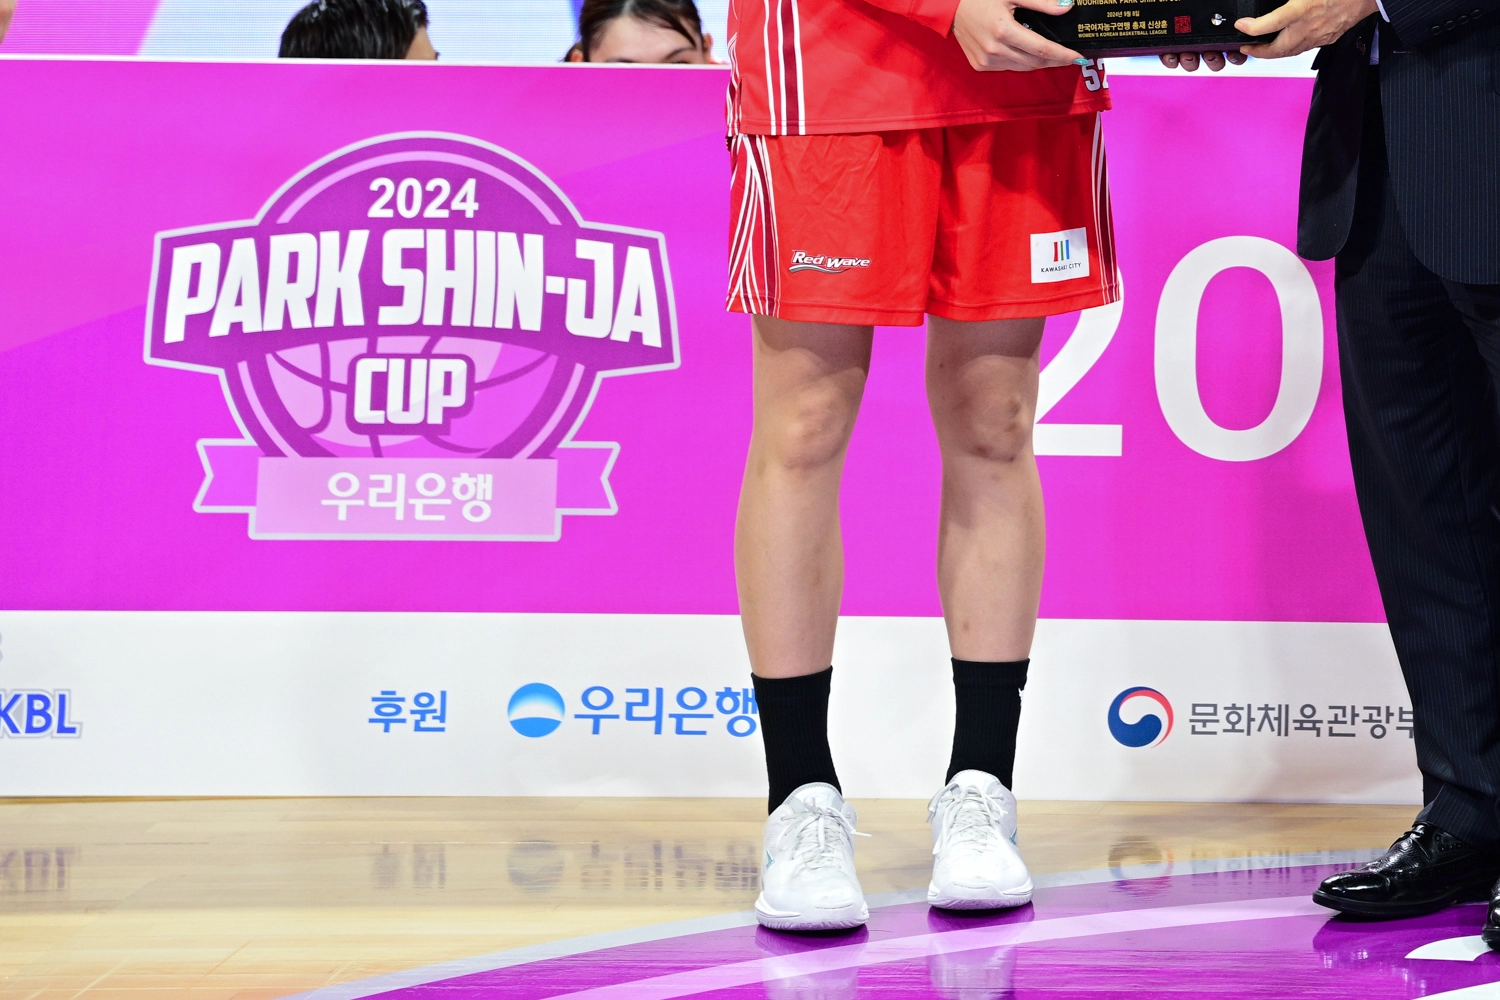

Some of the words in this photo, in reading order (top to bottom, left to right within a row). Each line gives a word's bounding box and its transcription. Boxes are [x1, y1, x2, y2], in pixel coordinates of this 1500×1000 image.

[1077, 22, 1131, 32] 한국여자농구연맹
[367, 177, 479, 218] 2024
[792, 250, 825, 265] Red
[1068, 262, 1081, 270] CITY
[163, 229, 370, 344] PARK
[377, 228, 662, 348] SHIN-JA
[353, 358, 468, 425] CUP
[321, 472, 494, 523] 우리은행
[368, 690, 448, 733] 후원
[574, 686, 758, 738] 우리은행
